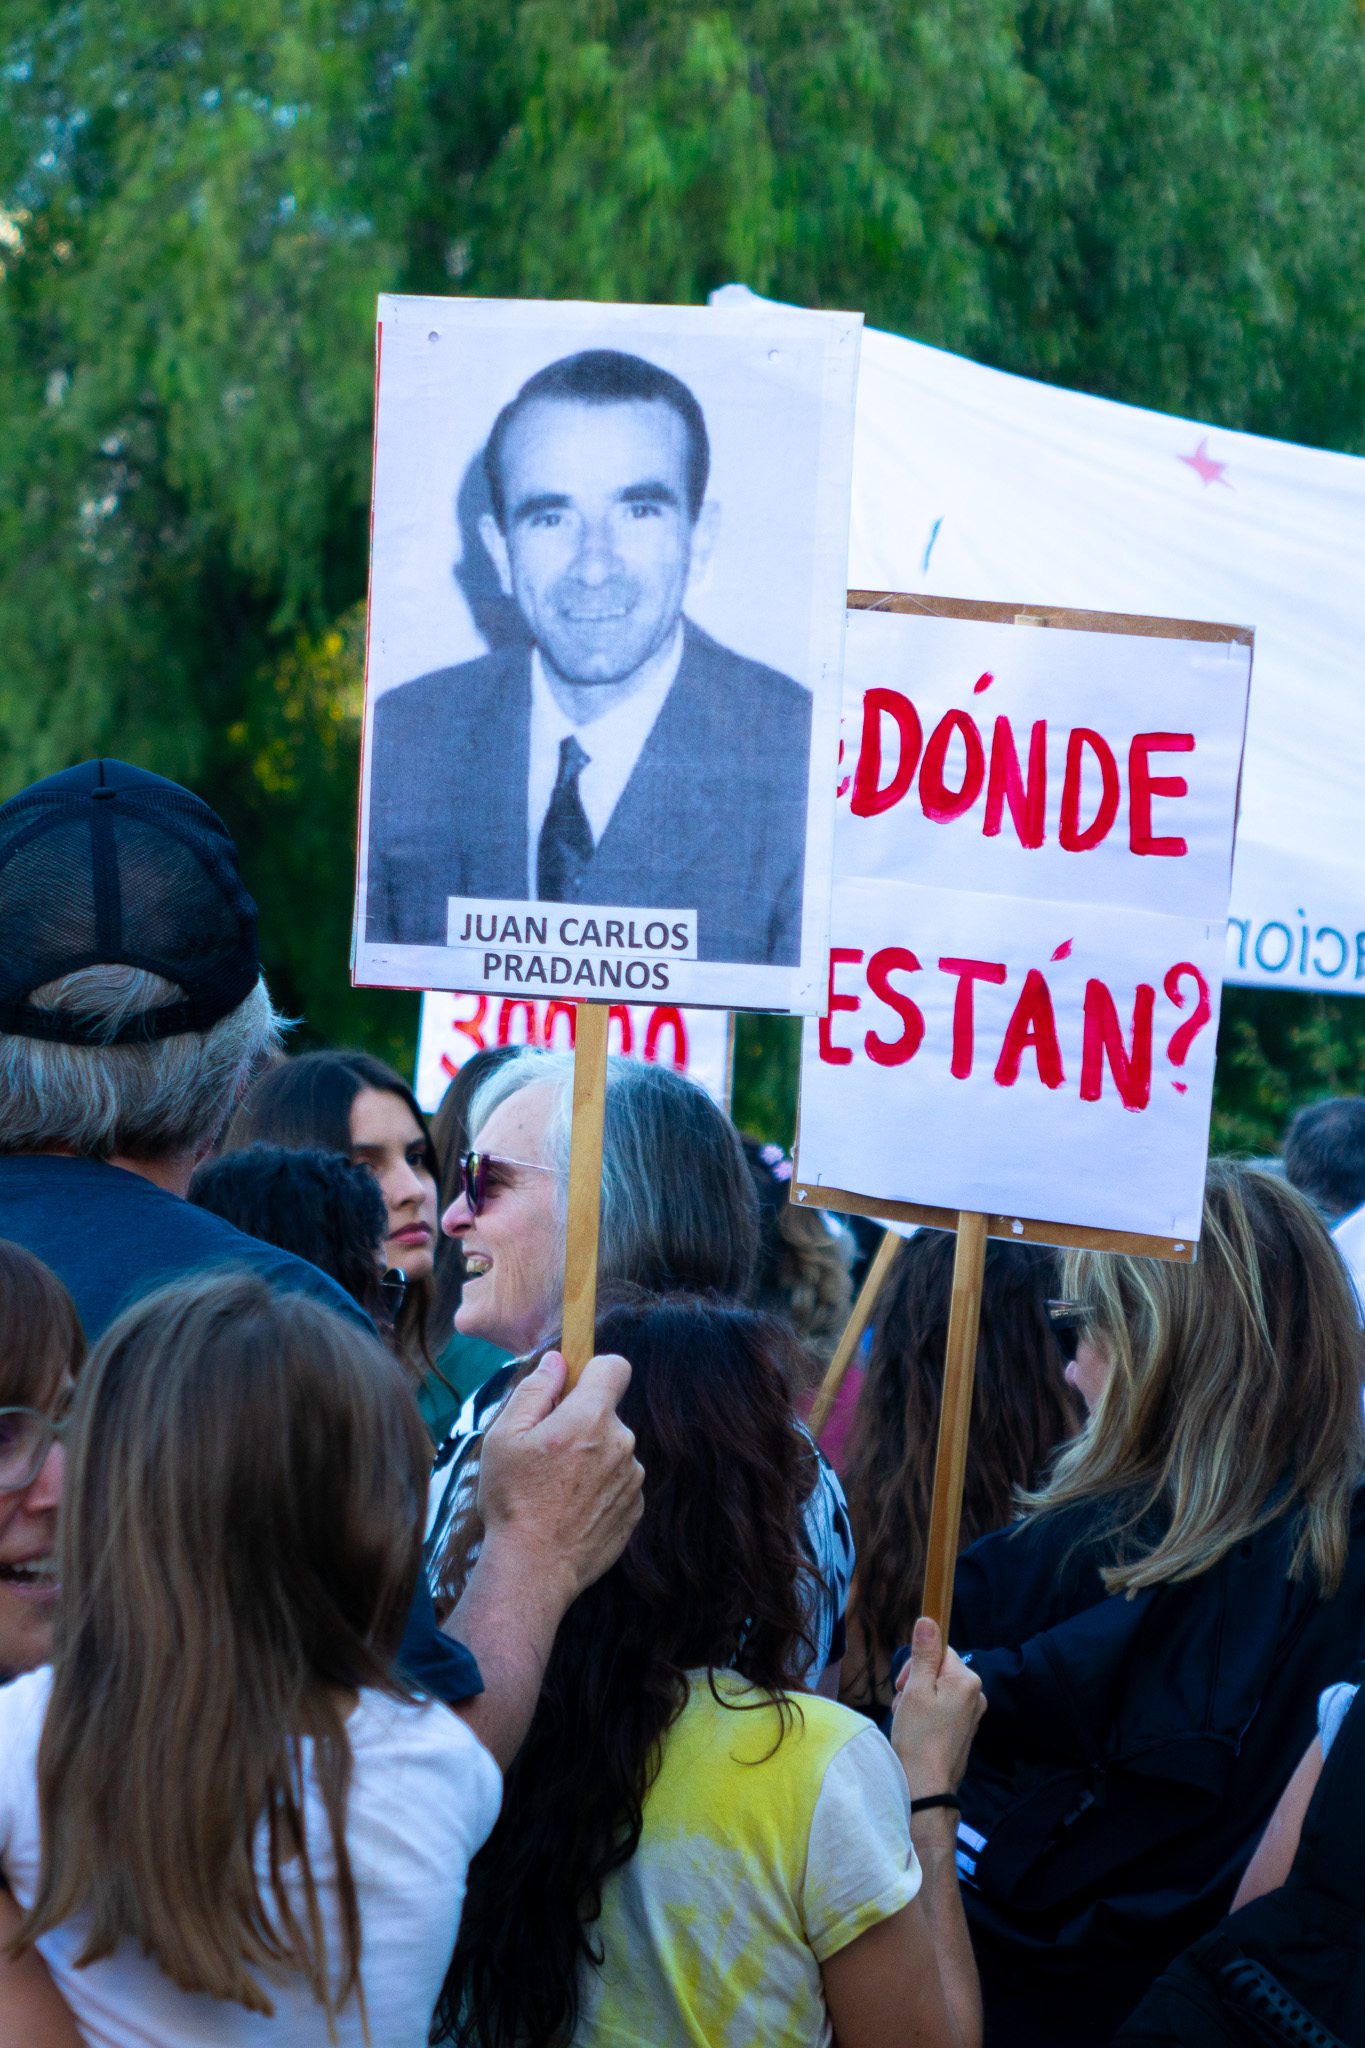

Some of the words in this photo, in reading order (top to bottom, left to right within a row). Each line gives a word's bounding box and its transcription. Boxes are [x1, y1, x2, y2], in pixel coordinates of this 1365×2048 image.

[837, 671, 1195, 857] DÓNDE
[460, 912, 548, 945] JUAN
[558, 918, 690, 951] CARLOS
[483, 953, 670, 990] PRADANOS
[819, 938, 1211, 1113] ESTÁN?
